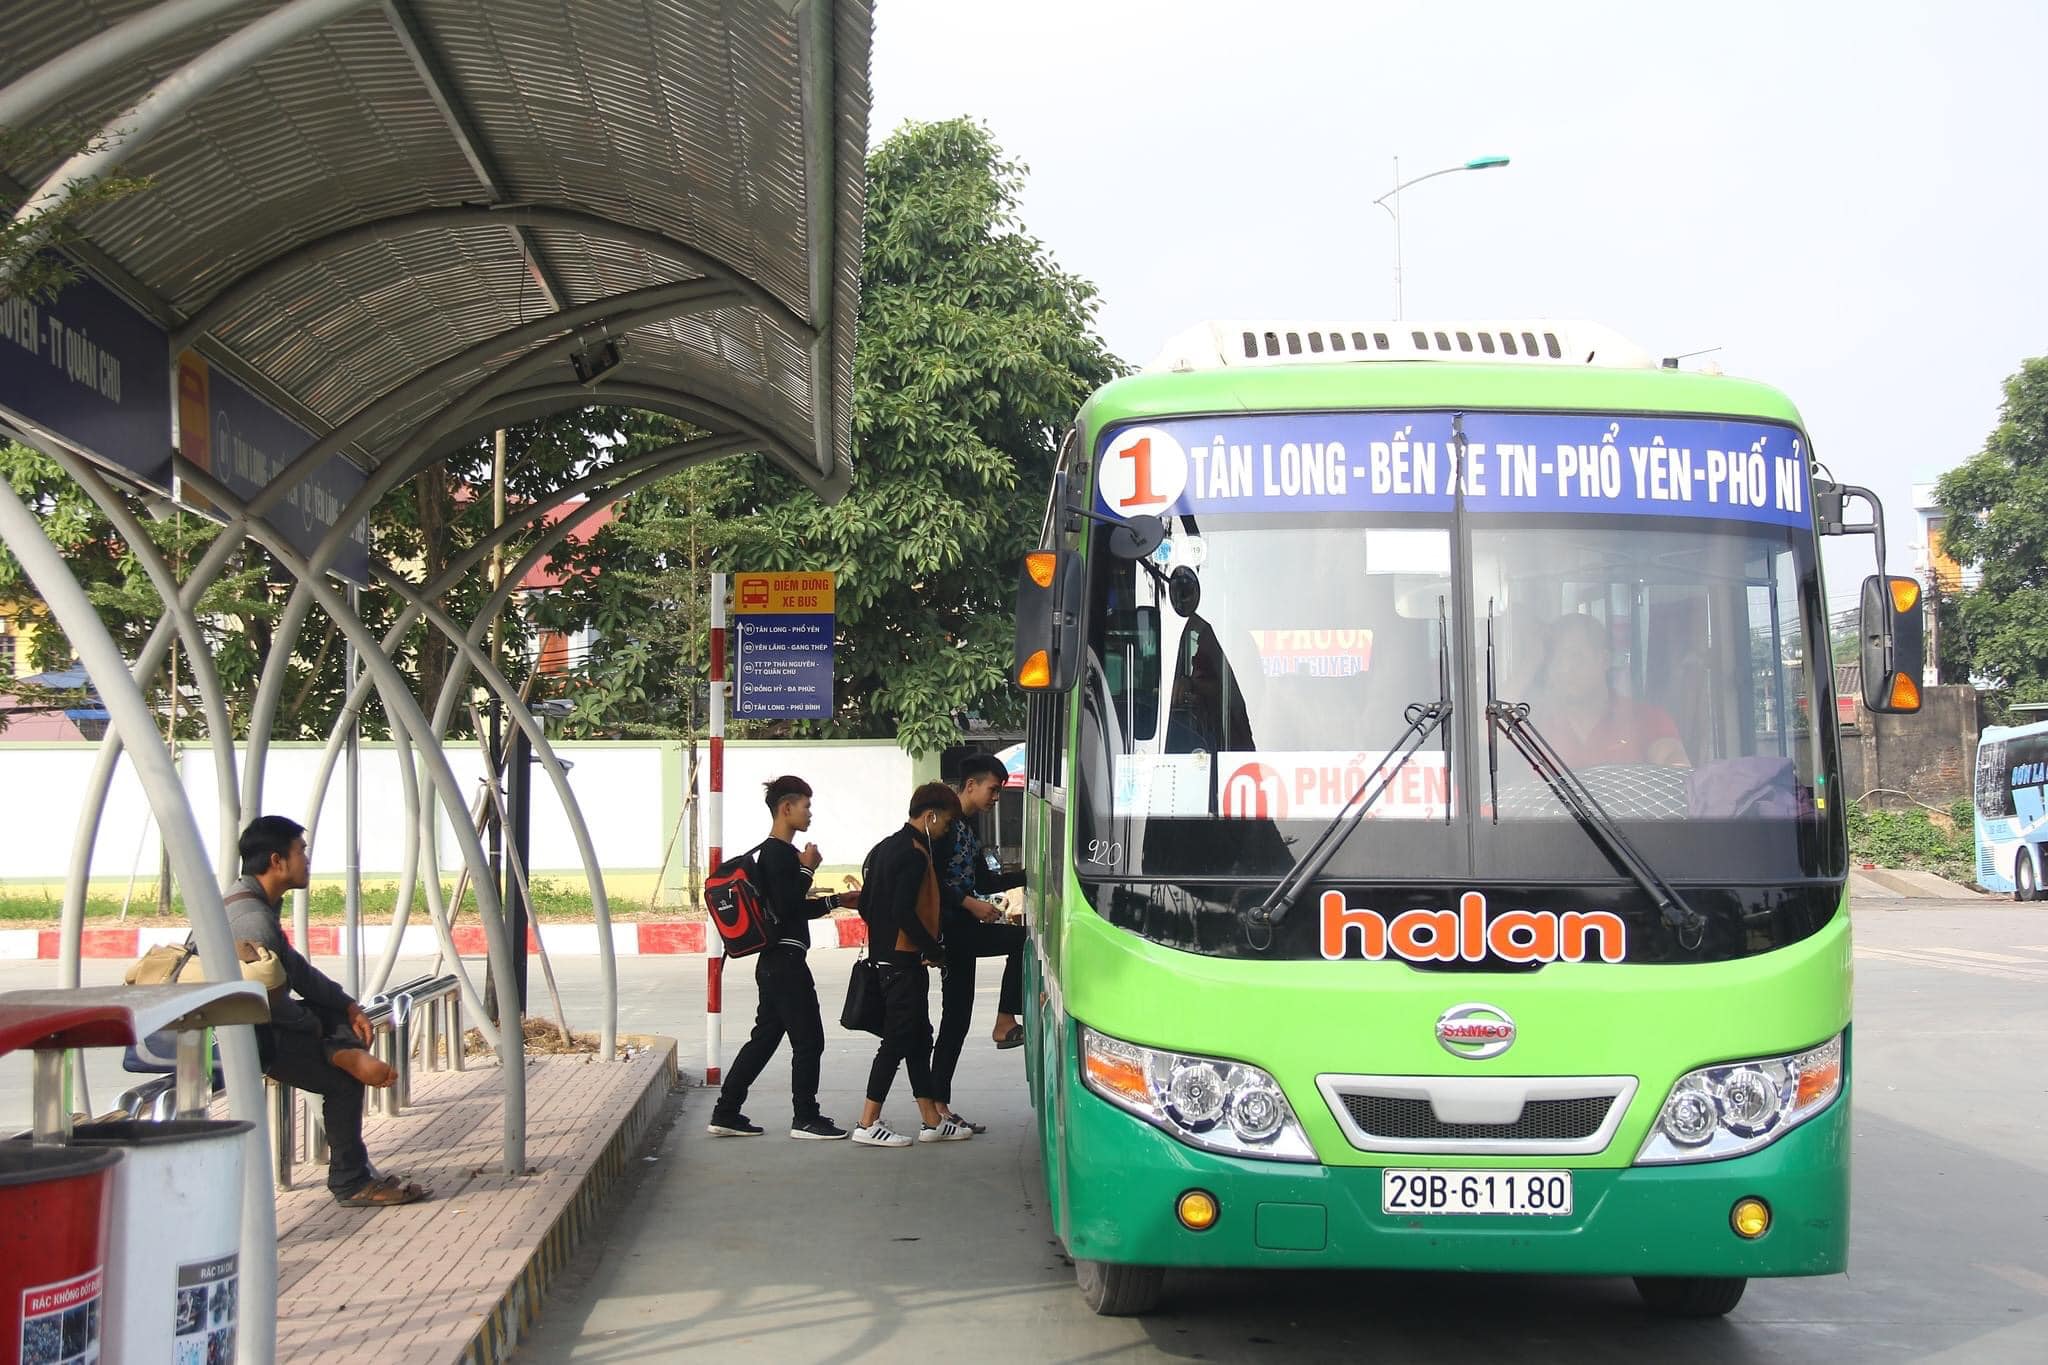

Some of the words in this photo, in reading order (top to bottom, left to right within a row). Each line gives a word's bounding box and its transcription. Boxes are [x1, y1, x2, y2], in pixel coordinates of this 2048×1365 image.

[1119, 437, 1167, 507] 1
[1191, 434, 1253, 499] TÂN
[1445, 441, 1487, 497] XE
[1775, 438, 1802, 513] NỈ
[774, 576, 799, 591] ĐIỂM
[782, 596, 795, 608] XE
[797, 596, 818, 608] BUS
[1087, 839, 1122, 867] 920
[1319, 889, 1627, 964] halan
[1442, 1023, 1510, 1039] SAMCO
[1390, 1175, 1565, 1209] 29B-611.80
[32, 1295, 52, 1311] RÁC
[53, 1285, 80, 1305] KHÔNG
